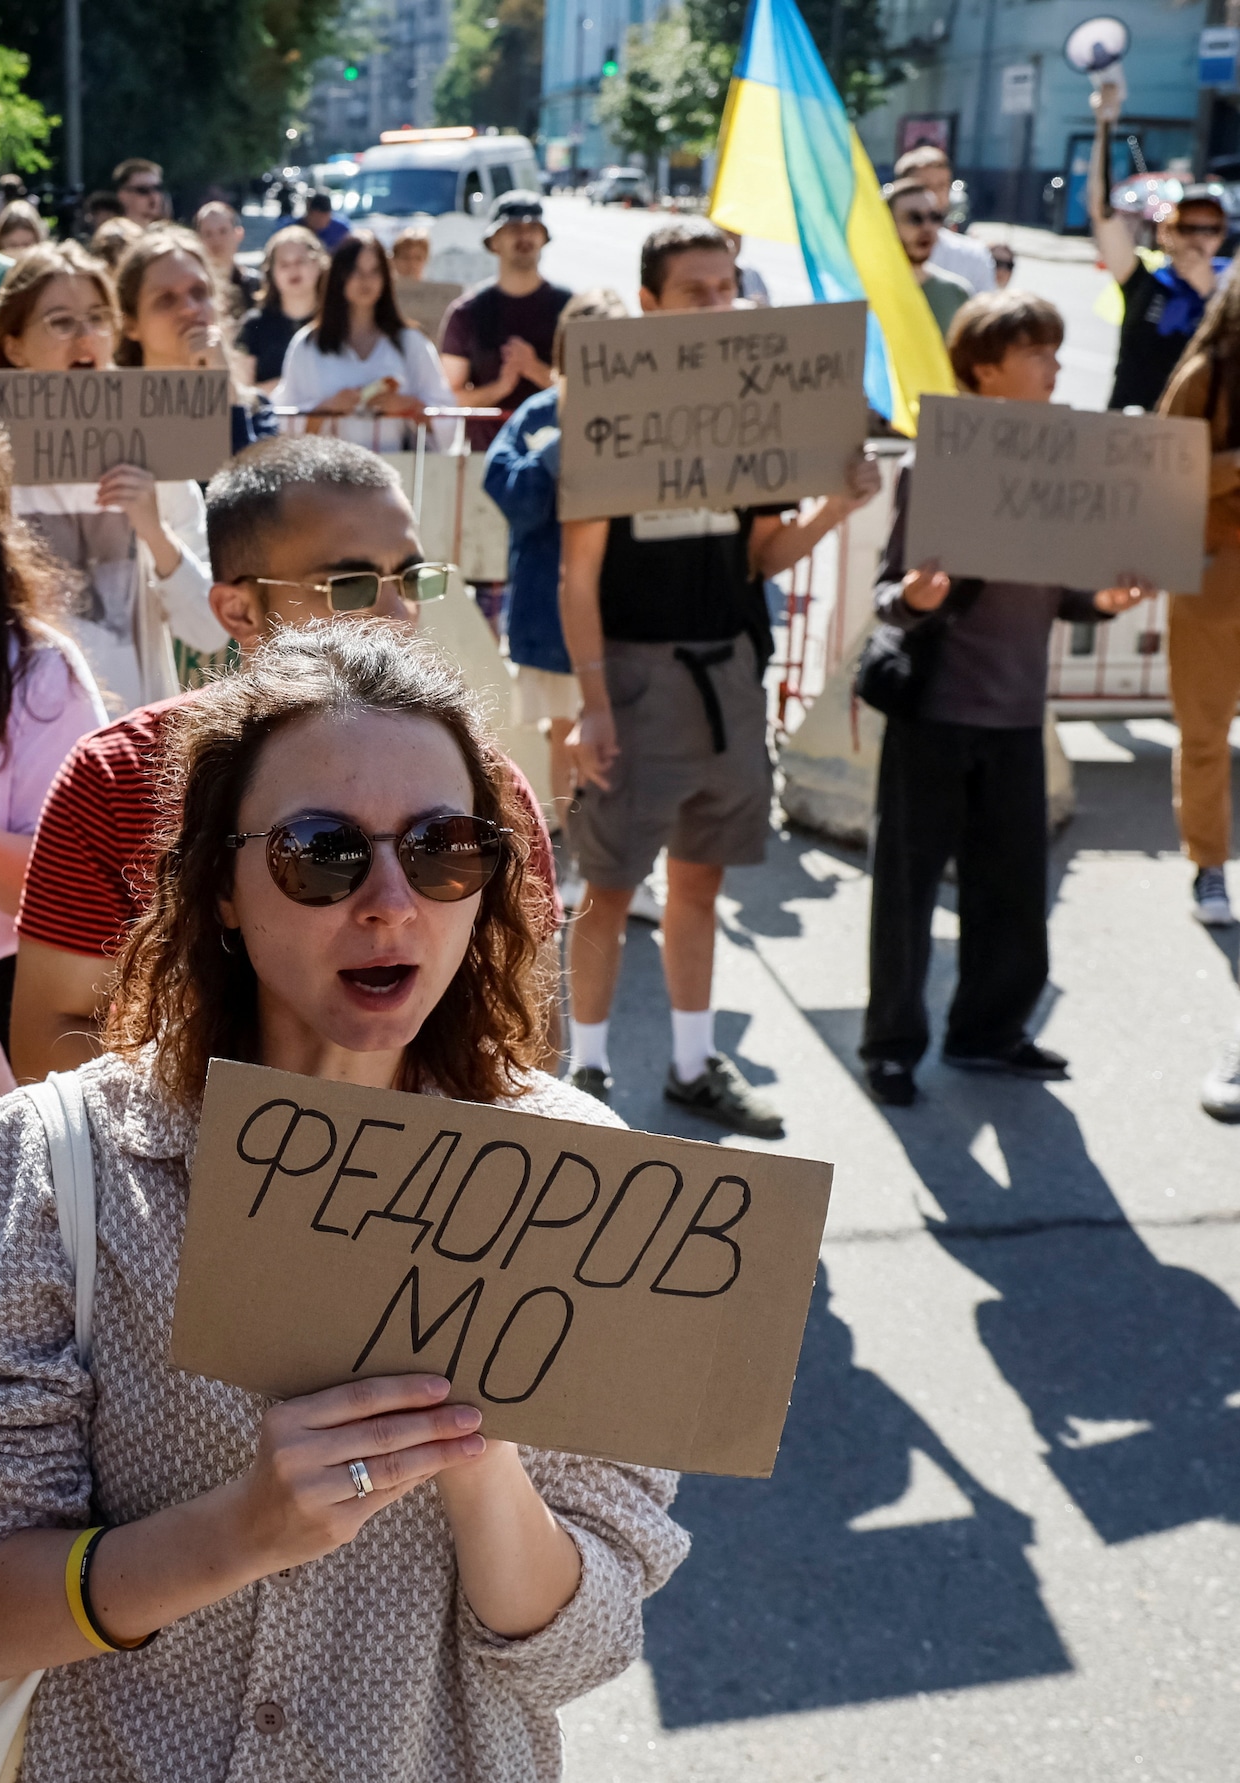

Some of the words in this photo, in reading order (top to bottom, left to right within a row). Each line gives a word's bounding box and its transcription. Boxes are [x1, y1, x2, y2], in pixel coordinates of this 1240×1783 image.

[677, 341, 706, 371] НЕ
[139, 373, 229, 419] ВЛАДИ
[583, 401, 784, 459] ФЕДОРОВА
[658, 454, 707, 503] НА
[236, 1098, 752, 1298] ФЕДОРОВ
[352, 1266, 574, 1404] МО
